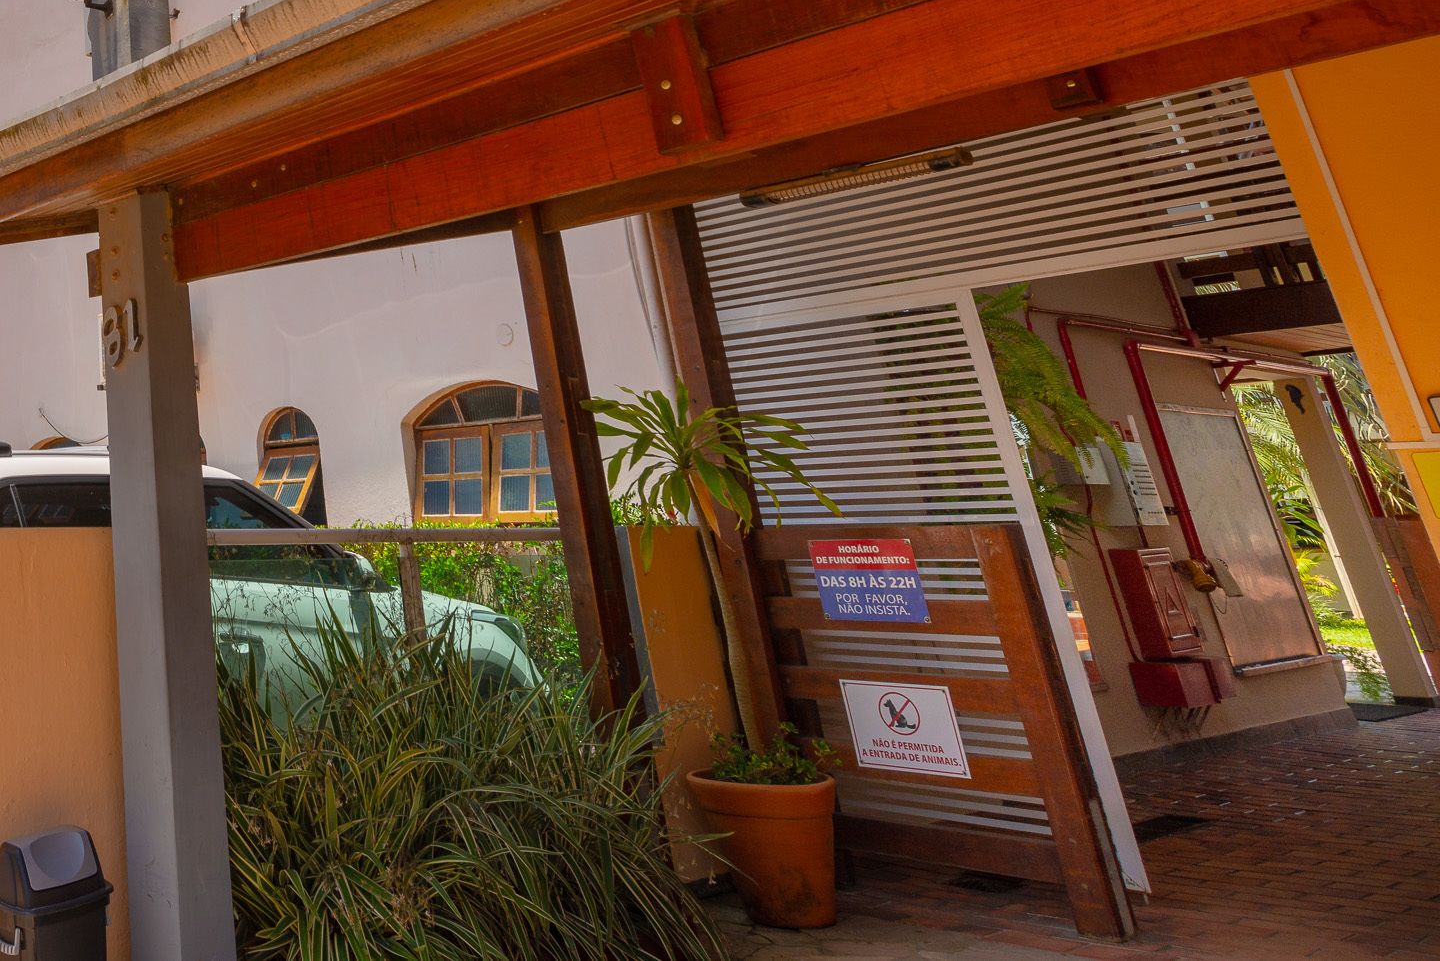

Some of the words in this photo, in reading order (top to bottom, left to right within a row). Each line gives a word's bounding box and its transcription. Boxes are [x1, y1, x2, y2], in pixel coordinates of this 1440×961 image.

[838, 544, 879, 554] HORÁRIO
[816, 556, 828, 564] DE
[829, 556, 910, 564] FUNCIONAMENTO:
[820, 575, 847, 588] DAS
[849, 576, 867, 588] 8H
[869, 574, 887, 588] ÀS
[889, 576, 917, 589] 22H
[835, 593, 860, 603] POR
[865, 593, 908, 606] FAVOR,
[838, 602, 863, 614] NÃO
[864, 604, 911, 616] INSISTA.
[872, 737, 890, 748] NÃO
[898, 741, 945, 754] PERMITIDA
[862, 748, 868, 757] A
[869, 749, 907, 762] ENTRADA
[908, 753, 921, 763] DE
[921, 755, 962, 767] ANIMAIS.
